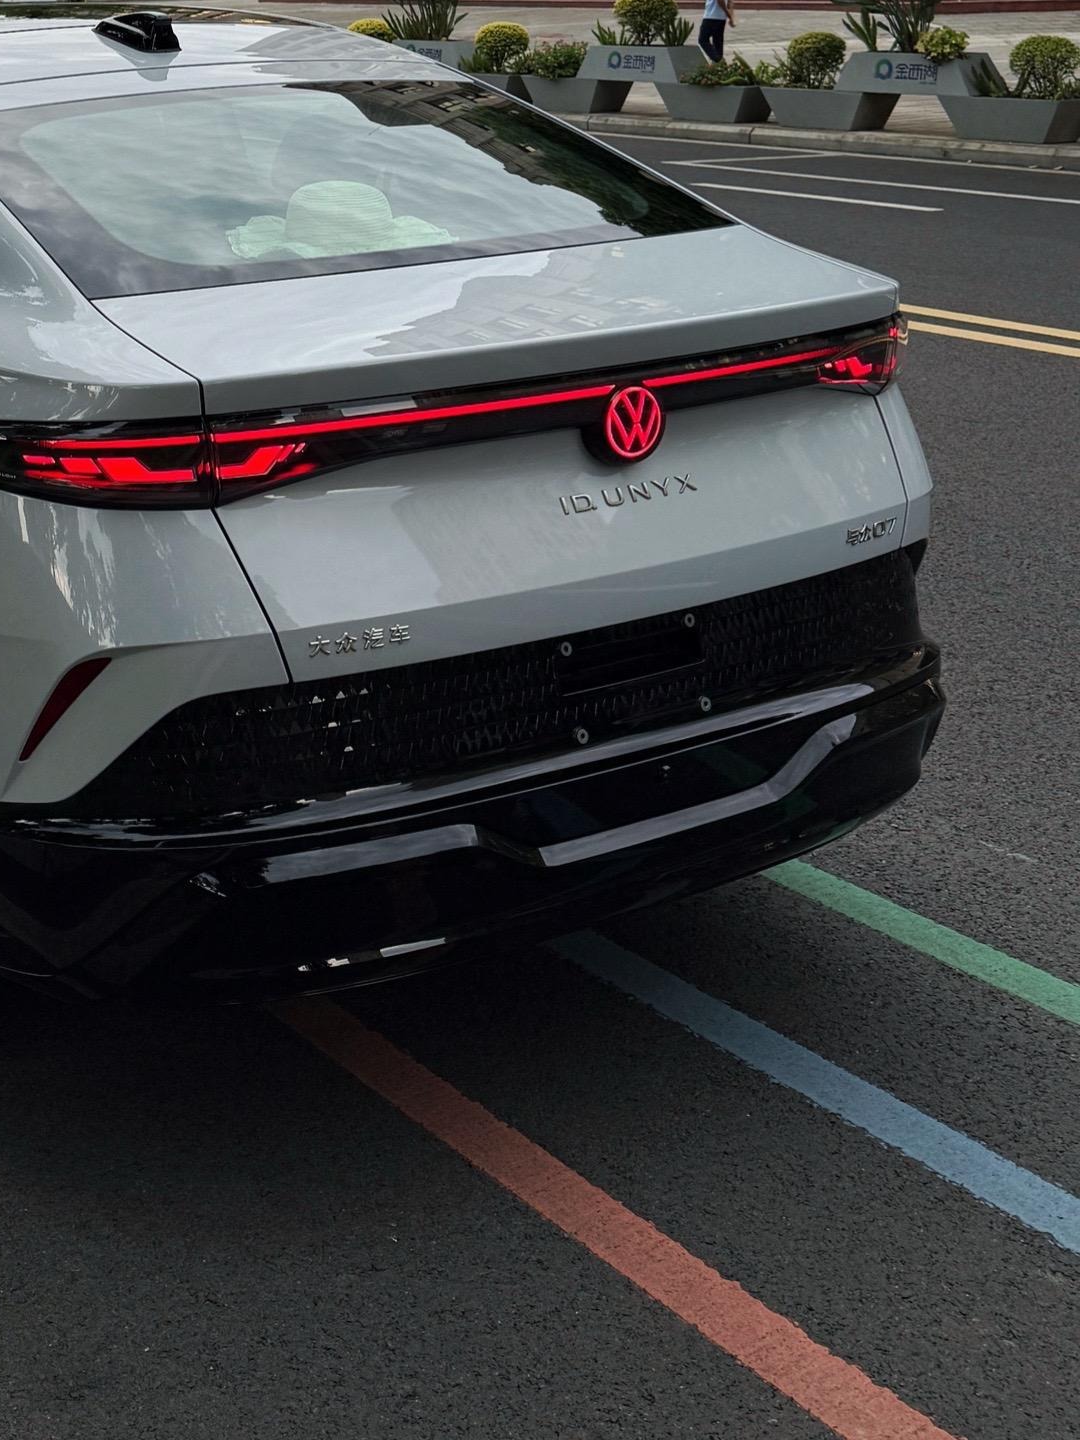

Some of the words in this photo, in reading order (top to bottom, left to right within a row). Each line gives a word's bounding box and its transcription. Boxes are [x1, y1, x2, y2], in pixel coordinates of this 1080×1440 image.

[622, 54, 656, 71] 金西湖
[894, 63, 938, 81] 金西湖
[309, 623, 411, 658] 大众汽车
